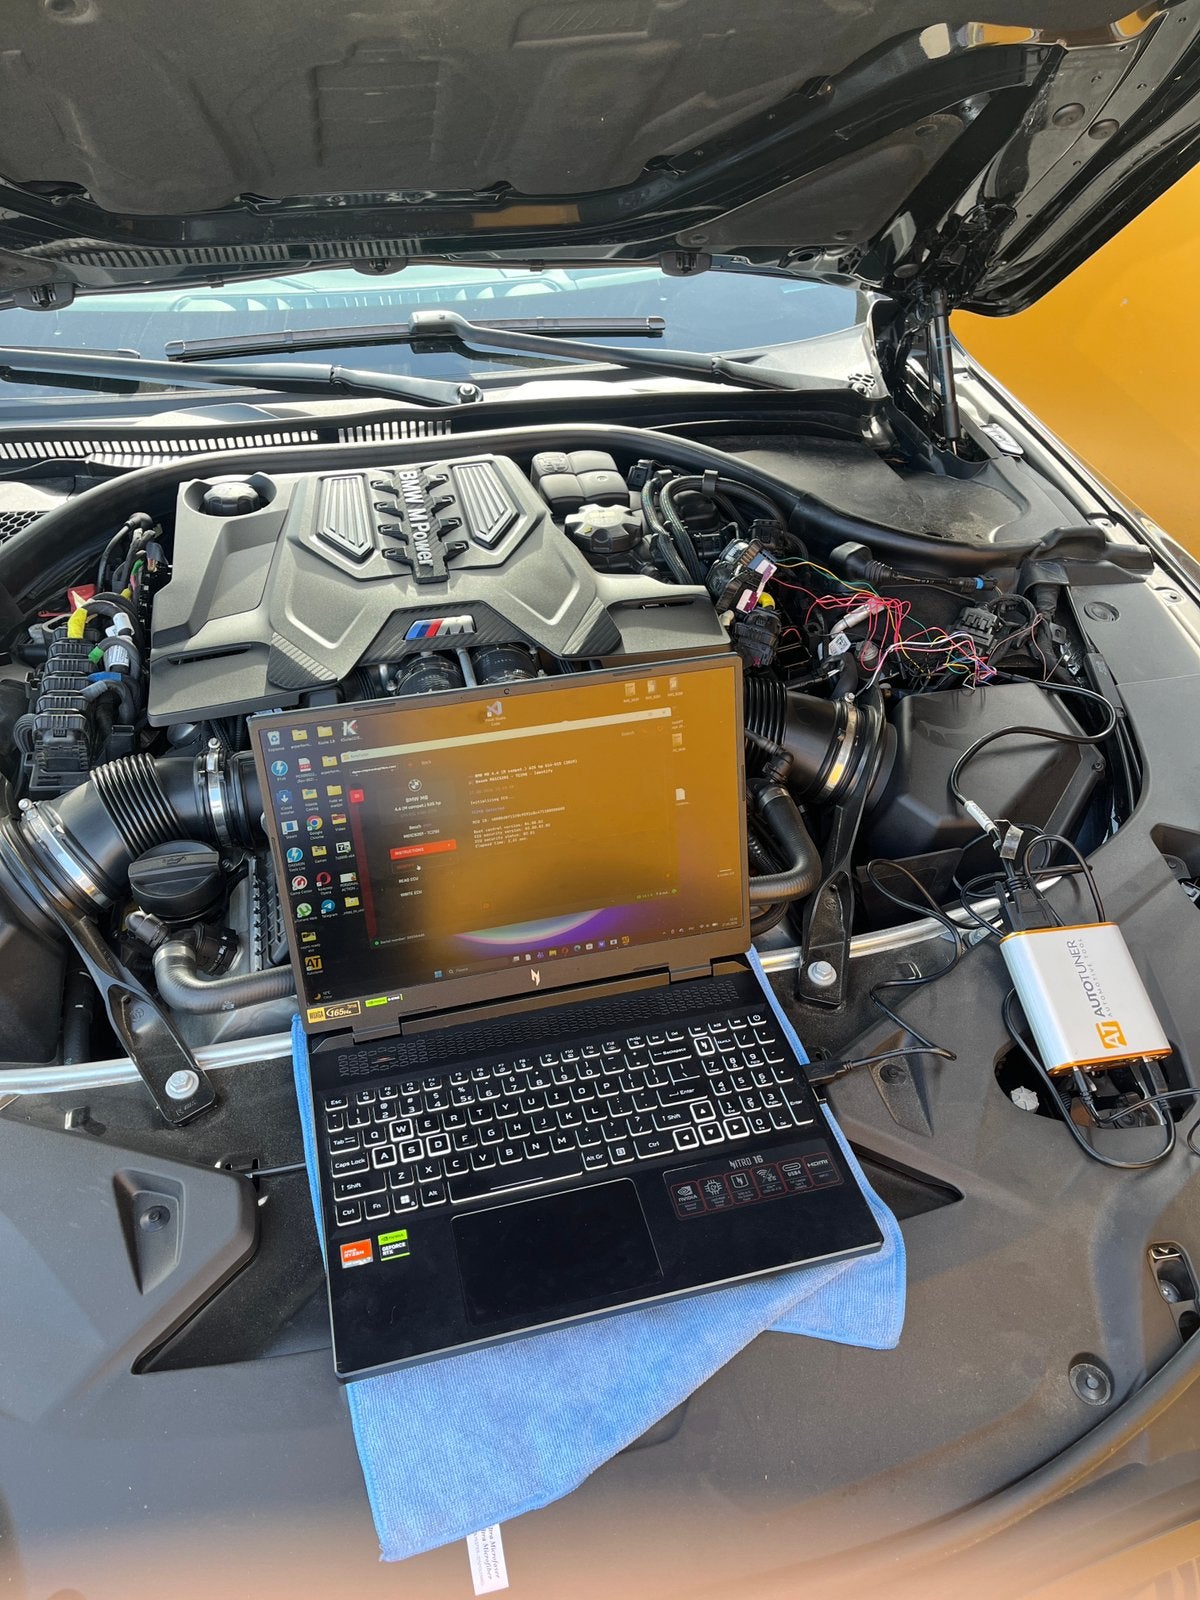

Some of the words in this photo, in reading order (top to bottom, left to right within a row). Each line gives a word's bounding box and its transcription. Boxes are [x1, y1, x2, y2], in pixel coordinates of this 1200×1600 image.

[400, 470, 424, 504] BMW
[1066, 939, 1106, 1017] AUTOTUNER
[1087, 963, 1113, 1017] AUTOMOTIVE
[1098, 1021, 1126, 1048] AT
[450, 1114, 458, 1122] R
[667, 1113, 682, 1121] Shift
[396, 1125, 407, 1133] W
[513, 1123, 521, 1131] H
[370, 1131, 378, 1139] Q
[462, 1134, 468, 1142] F
[380, 1152, 389, 1160] A
[335, 1161, 350, 1169] Caps
[351, 1158, 366, 1166] Lock
[729, 1157, 752, 1169] NITRO
[753, 1155, 764, 1165] 16
[807, 1159, 828, 1168] HDMI
[342, 1208, 355, 1216] Ctrl
[382, 1241, 406, 1251] GEFORCE
